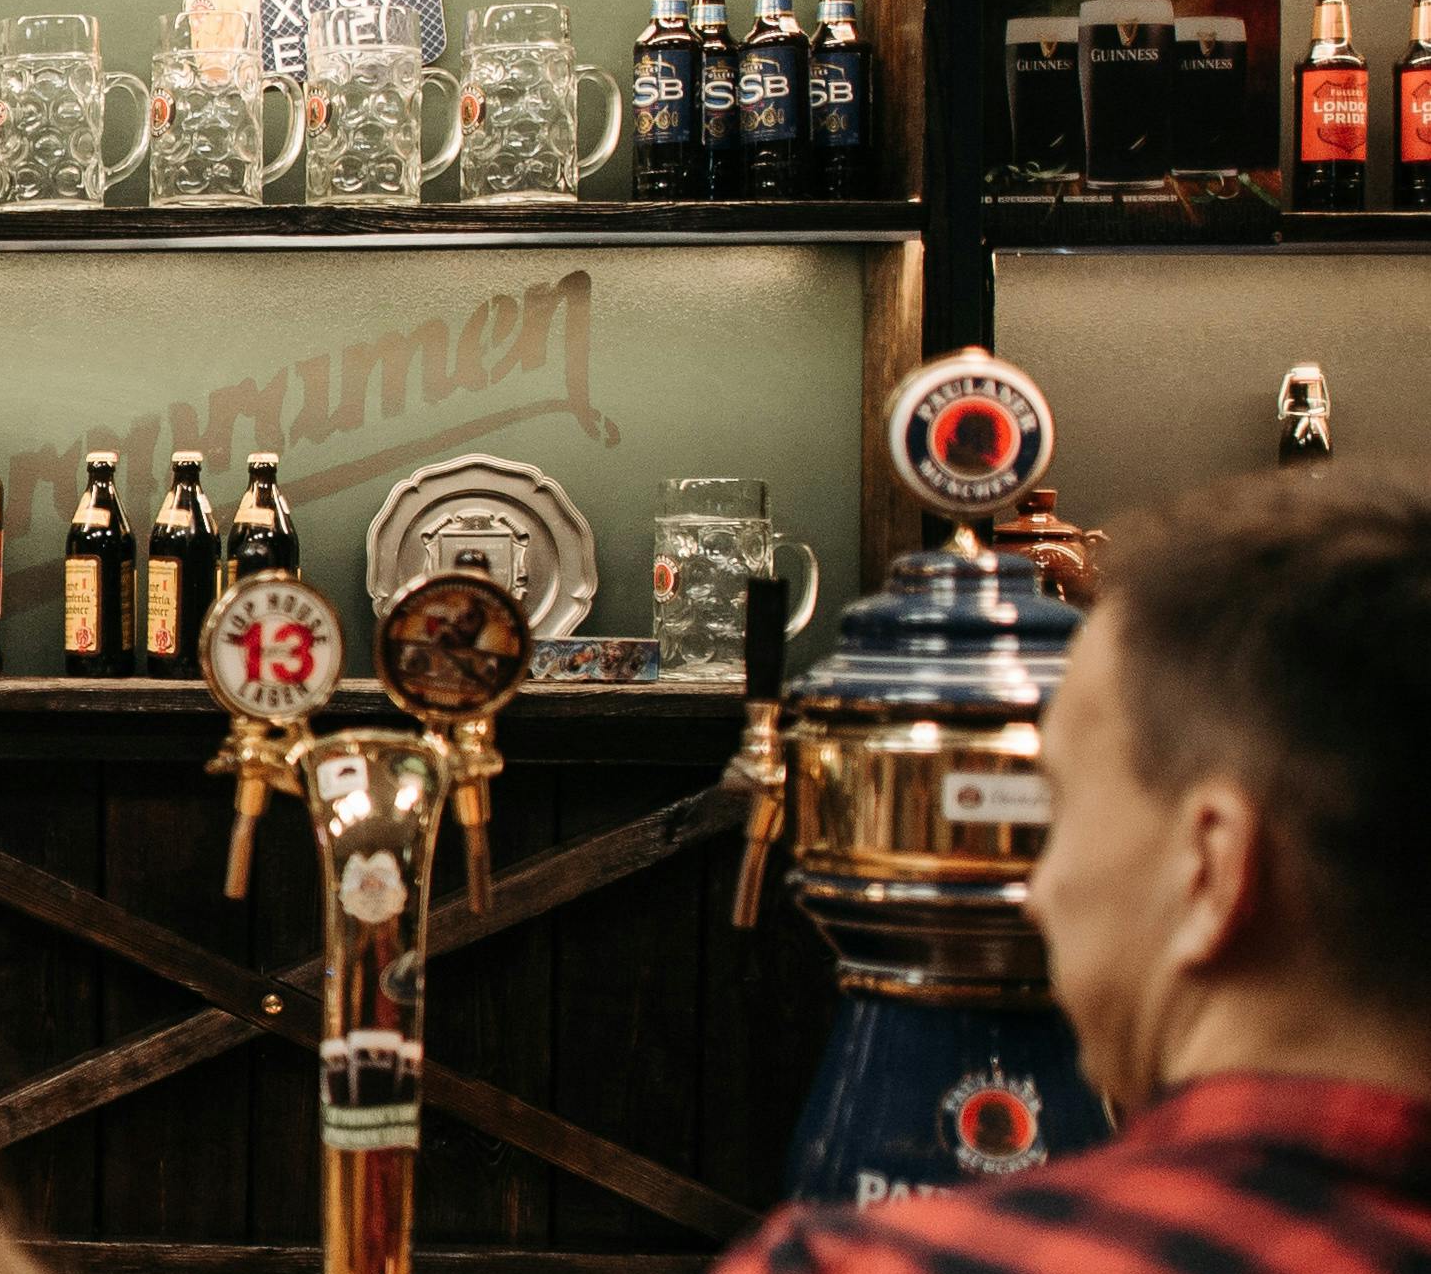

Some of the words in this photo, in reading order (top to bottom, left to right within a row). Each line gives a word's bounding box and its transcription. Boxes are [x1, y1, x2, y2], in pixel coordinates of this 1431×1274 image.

[1090, 48, 1159, 63] GUINNESS
[633, 76, 684, 108] SB
[739, 74, 790, 105] SB
[810, 78, 854, 108] SB
[1313, 100, 1366, 114] LONDO
[916, 377, 1038, 434] PAULANER
[234, 621, 315, 684] 13
